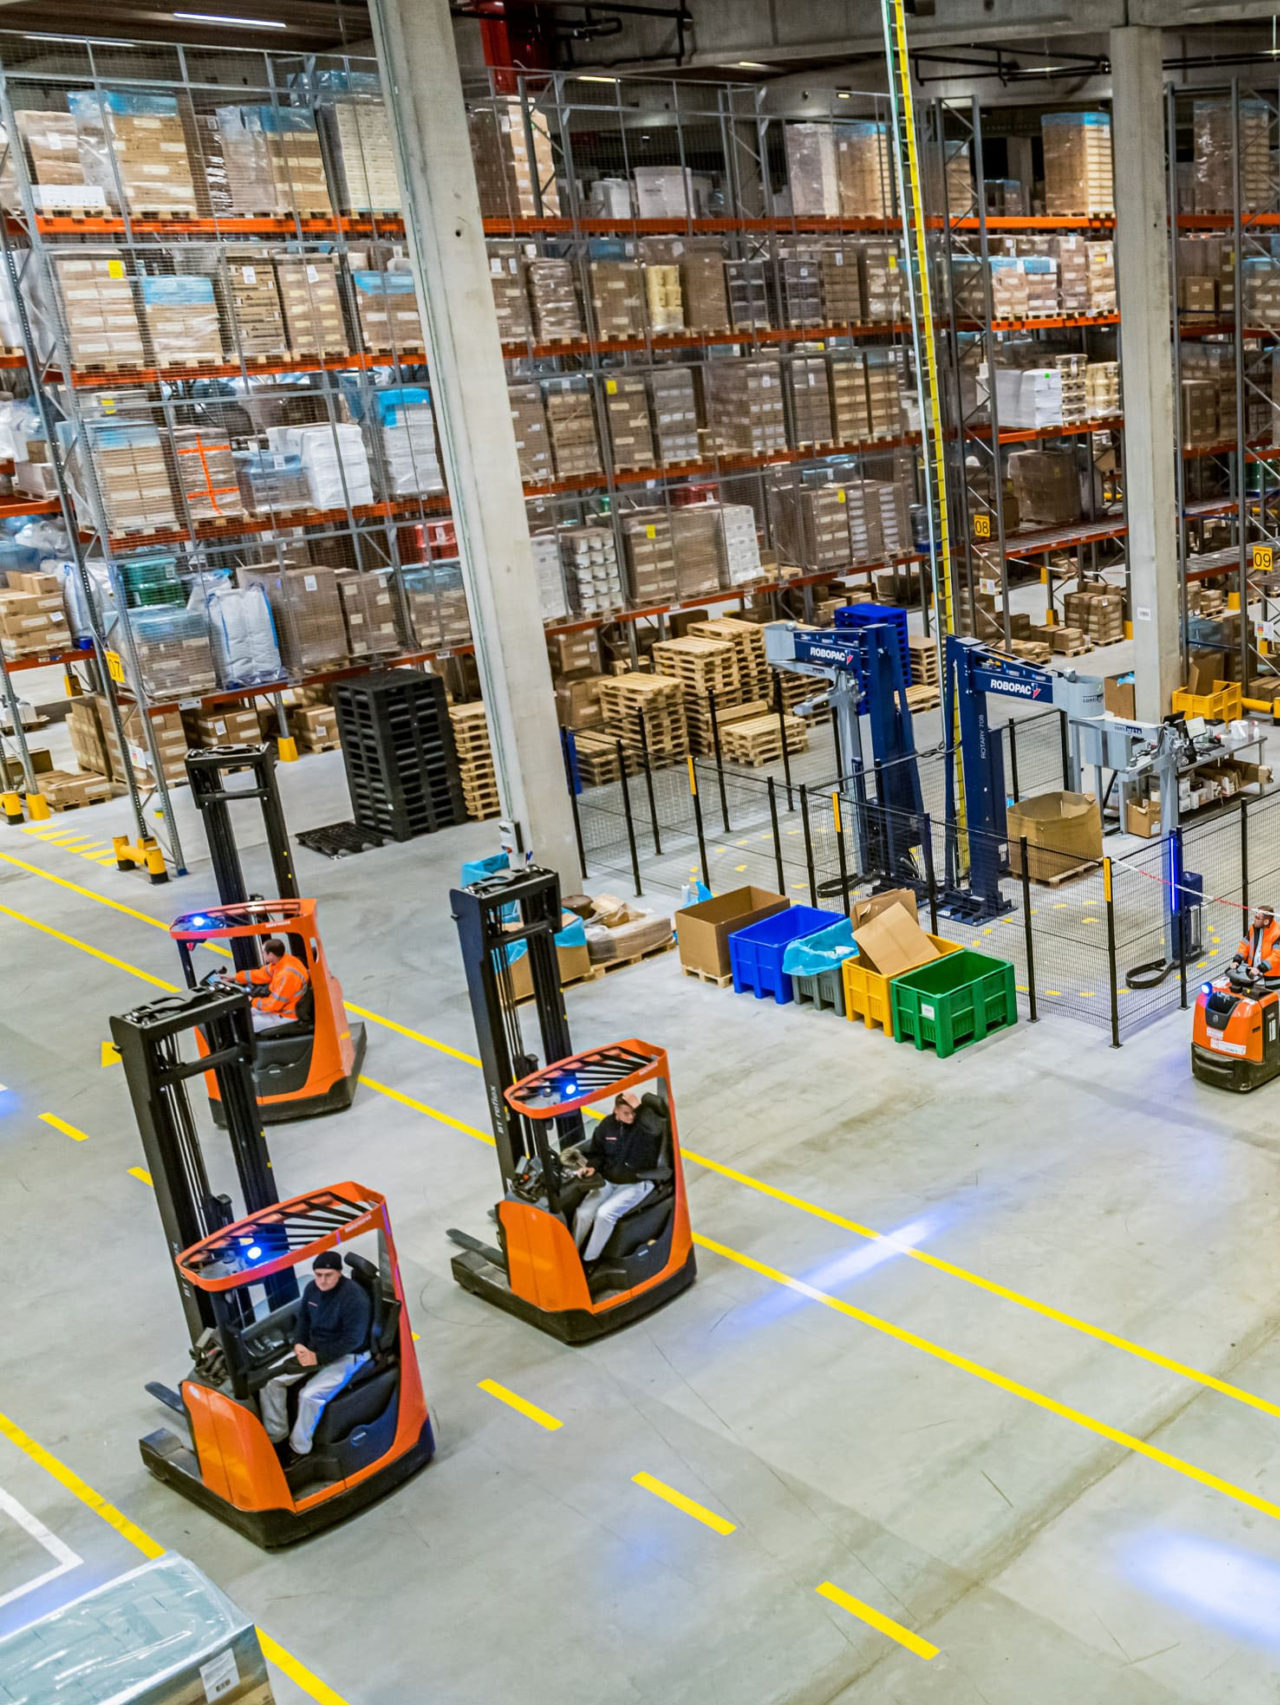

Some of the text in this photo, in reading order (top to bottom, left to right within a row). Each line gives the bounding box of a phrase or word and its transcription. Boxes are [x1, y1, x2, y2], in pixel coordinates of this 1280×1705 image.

[975, 519, 990, 535] 08
[1254, 552, 1271, 568] 09
[810, 646, 846, 662] ROBOPAC
[109, 657, 121, 679] 07
[989, 678, 1032, 696] ROBOPAC
